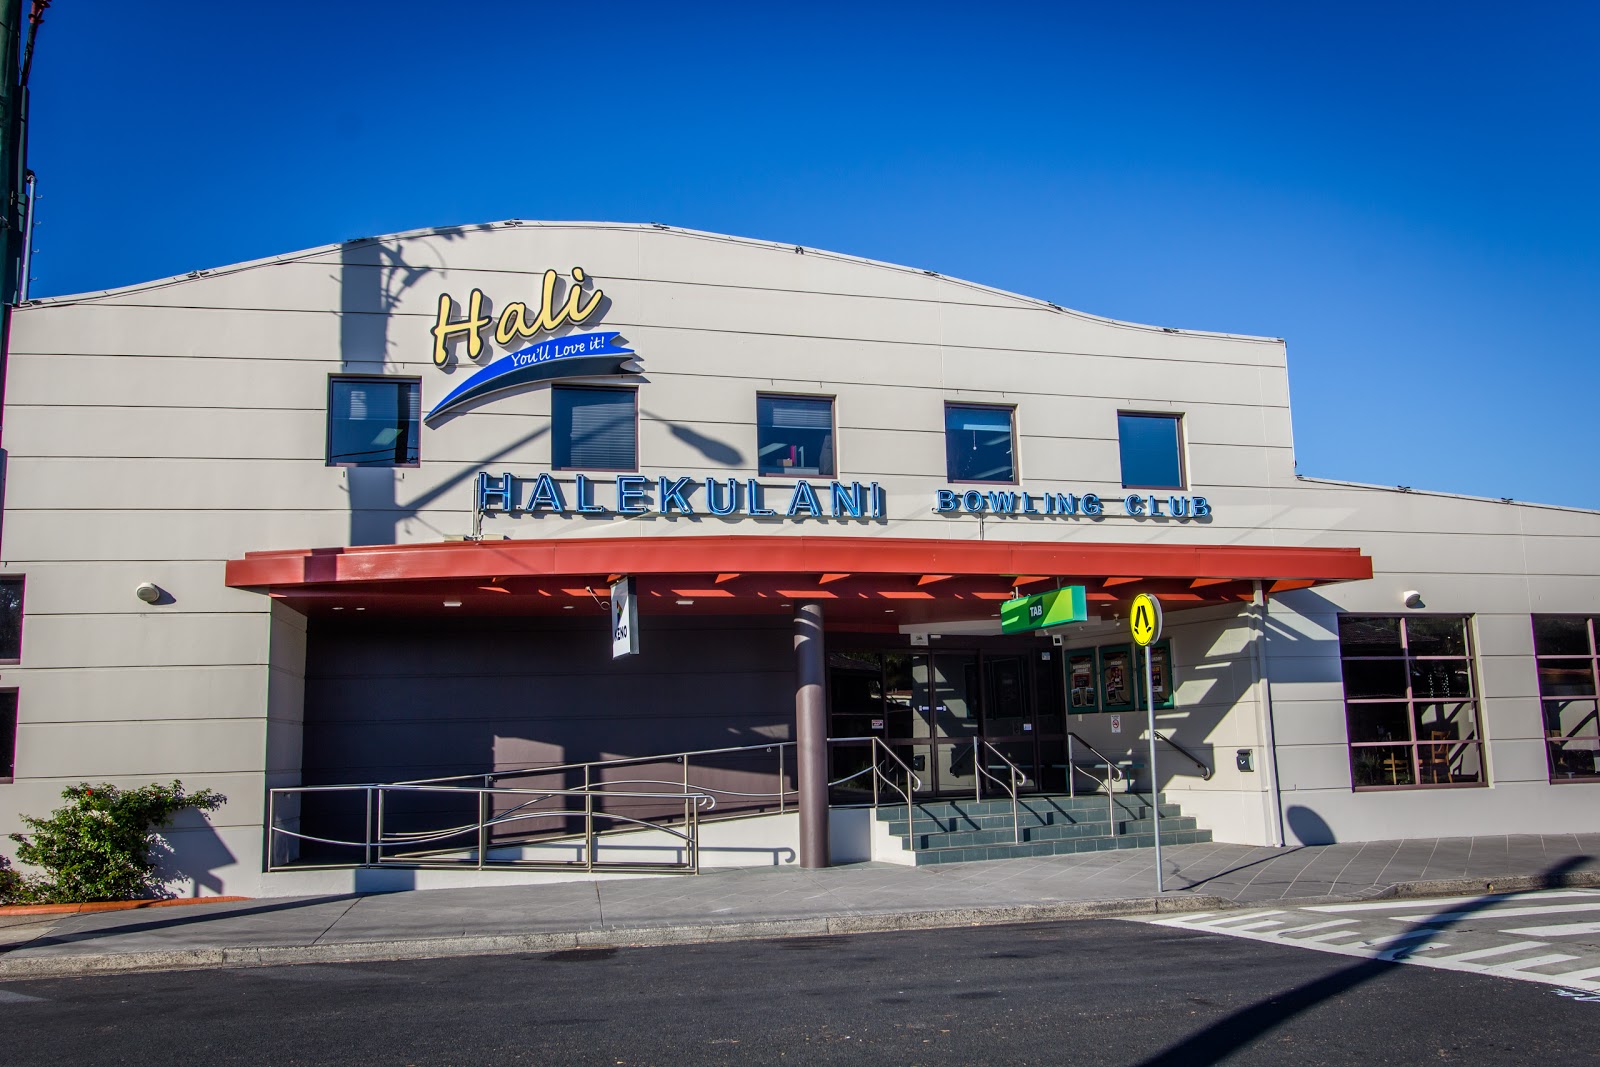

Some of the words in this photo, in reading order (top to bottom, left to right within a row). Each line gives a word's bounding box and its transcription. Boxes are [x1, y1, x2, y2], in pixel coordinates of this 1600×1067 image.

[430, 266, 604, 369] Hali
[511, 345, 551, 368] You'll
[555, 341, 585, 359] Love
[589, 336, 606, 351] it!
[478, 472, 880, 519] HALEKULANI
[935, 489, 1102, 516] BOWLING
[1124, 494, 1210, 518] CLUB
[1029, 604, 1043, 618] TAB
[614, 625, 628, 641] KENO
